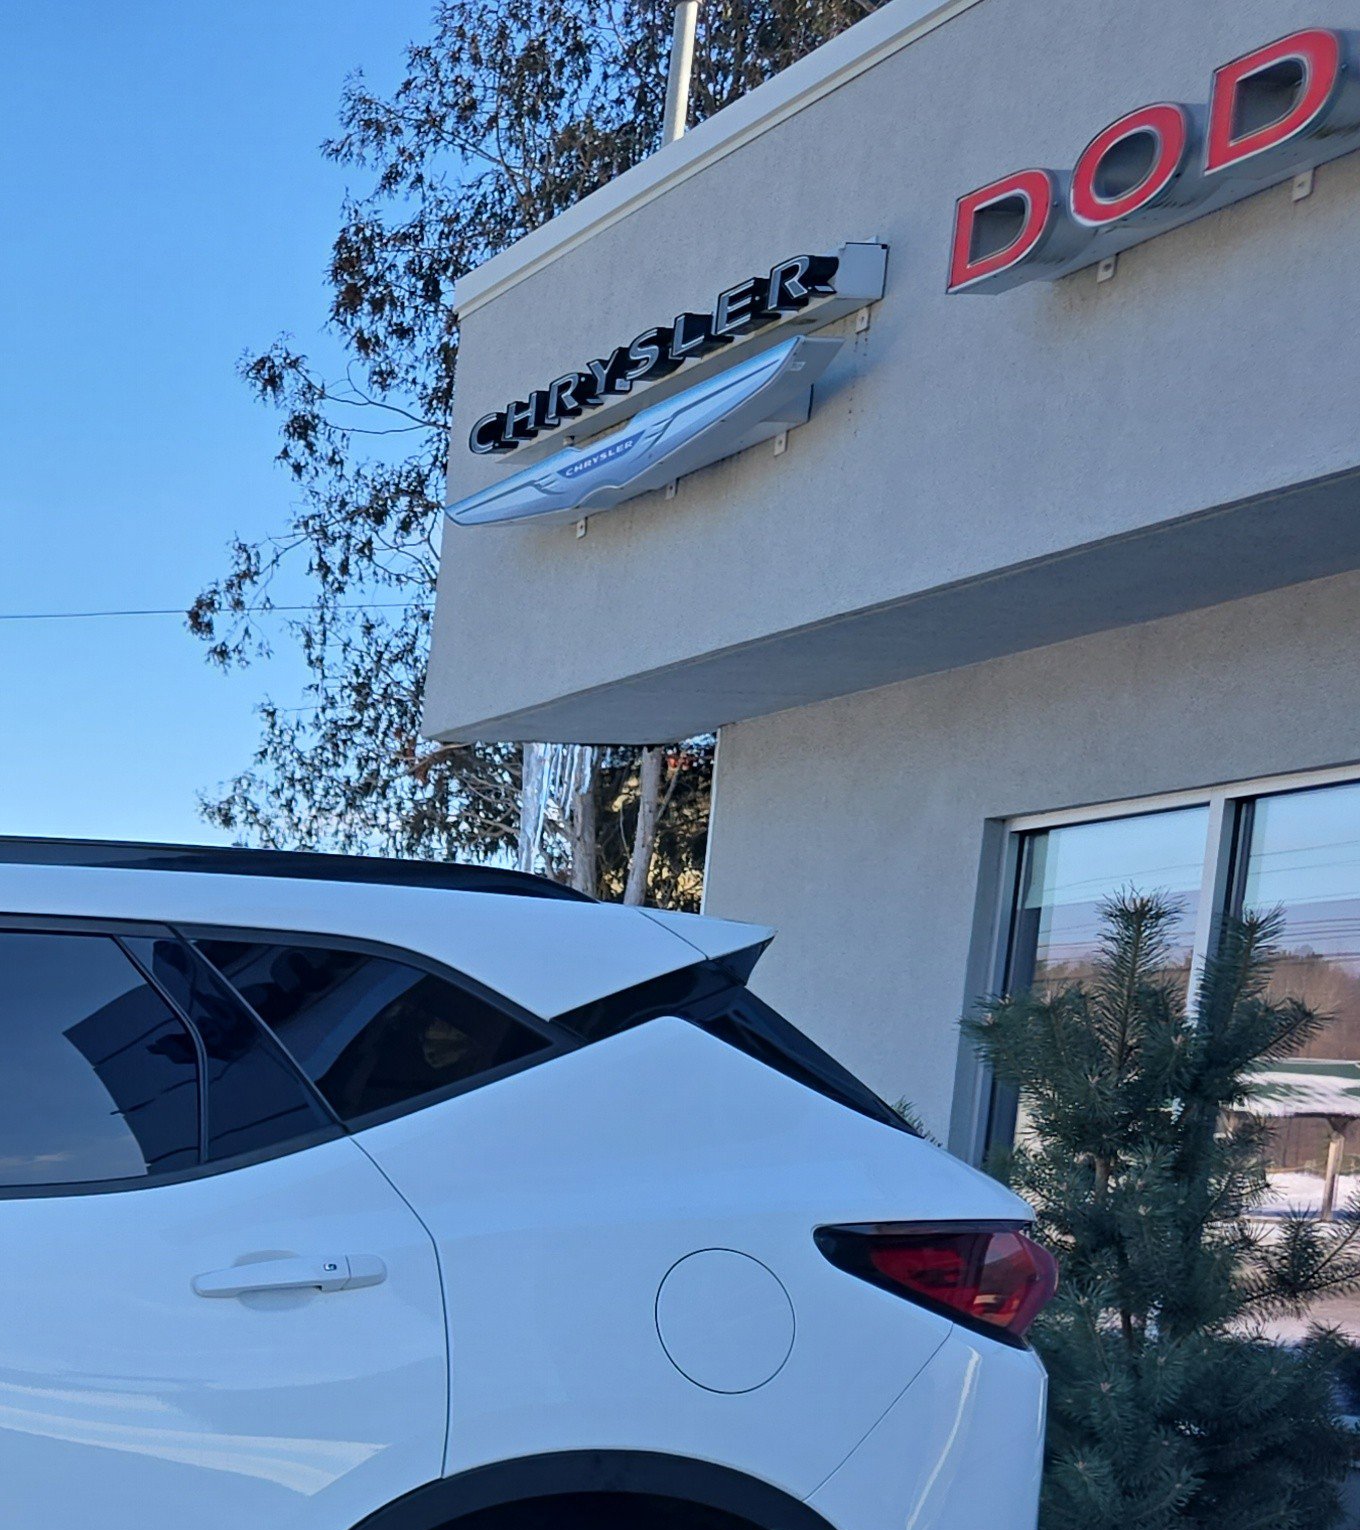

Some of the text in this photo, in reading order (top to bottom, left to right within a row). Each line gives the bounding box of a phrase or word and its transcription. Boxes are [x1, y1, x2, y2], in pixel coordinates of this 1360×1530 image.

[947, 26, 1341, 294] DOD
[468, 253, 820, 455] CHRYSLER
[565, 440, 634, 477] CHRYSLER
